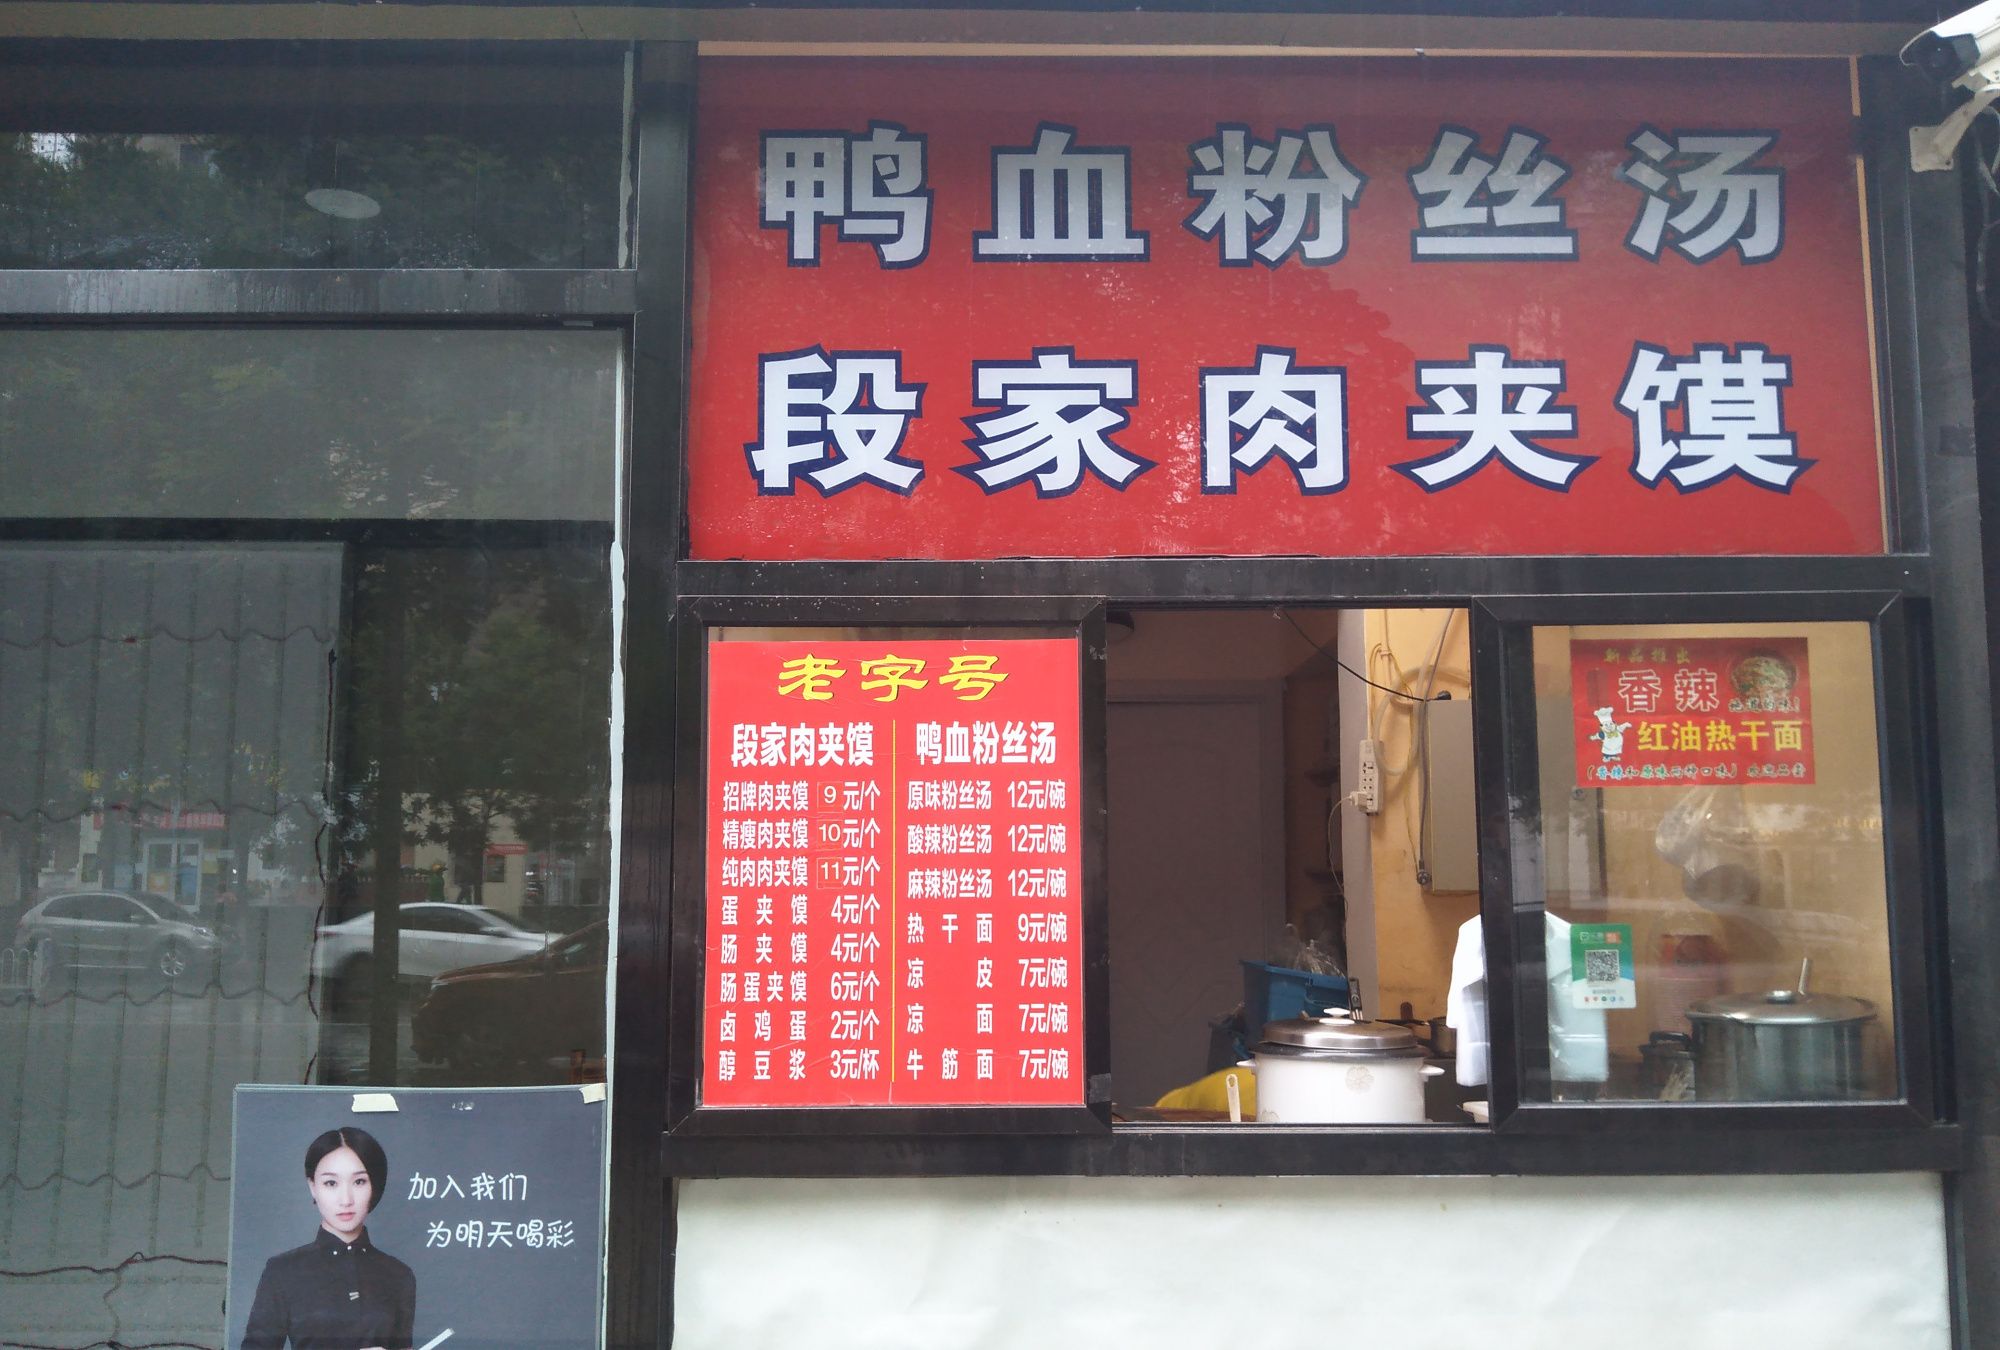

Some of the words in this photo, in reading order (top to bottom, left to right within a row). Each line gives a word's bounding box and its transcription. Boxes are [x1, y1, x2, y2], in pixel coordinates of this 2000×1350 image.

[760, 121, 1784, 266] 鸭血粉丝汤
[746, 345, 1812, 494] 段家肉夹馍
[777, 653, 1009, 702] 老字号
[1617, 668, 1720, 713] 香辣
[730, 721, 874, 768] 段家肉夹馍
[915, 720, 1057, 766] 鸭血粉丝汤
[1637, 720, 1803, 752] 红油热干面
[722, 780, 809, 813] 招牌肉夹馍
[823, 779, 881, 811] 9元/个
[907, 779, 992, 811] 原味粉丝汤
[1007, 778, 1066, 810] 12元/碗
[722, 817, 809, 850] 精瘦肉夹馍
[818, 817, 881, 849] 10元/个
[907, 823, 993, 855] 酸辣粉丝汤
[1007, 822, 1067, 854] 12元/碗
[721, 855, 809, 888] 纯肉肉夹馍
[820, 855, 881, 887] 11元/个
[907, 867, 993, 900] 麻辣粉丝汤
[1007, 866, 1067, 899] 12元/碗
[721, 894, 808, 926] 蛋夹馍
[830, 894, 881, 925] 4元/个
[907, 912, 993, 944] 热干面
[1017, 911, 1068, 943] 9元/碗
[720, 931, 808, 965] 肠夹馍
[830, 931, 881, 964] 4元/个
[719, 970, 808, 1003] 肠蛋夹馍
[830, 970, 881, 1002] 6元/个
[906, 956, 993, 989] 凉皮
[1018, 956, 1068, 989] 7元/碗
[719, 1009, 807, 1043] 卤鸡蛋
[830, 1008, 880, 1041] 2元/个
[906, 1002, 994, 1035] 凉面
[1018, 1001, 1069, 1034] 7元/碗
[718, 1048, 806, 1082] 醇豆浆
[829, 1047, 880, 1080] 3元/杯
[906, 1047, 994, 1081] 牛筋面
[1018, 1047, 1069, 1080] 7元/碗
[407, 1171, 528, 1201] 加入我们
[425, 1218, 575, 1249] 为明天喝彩
